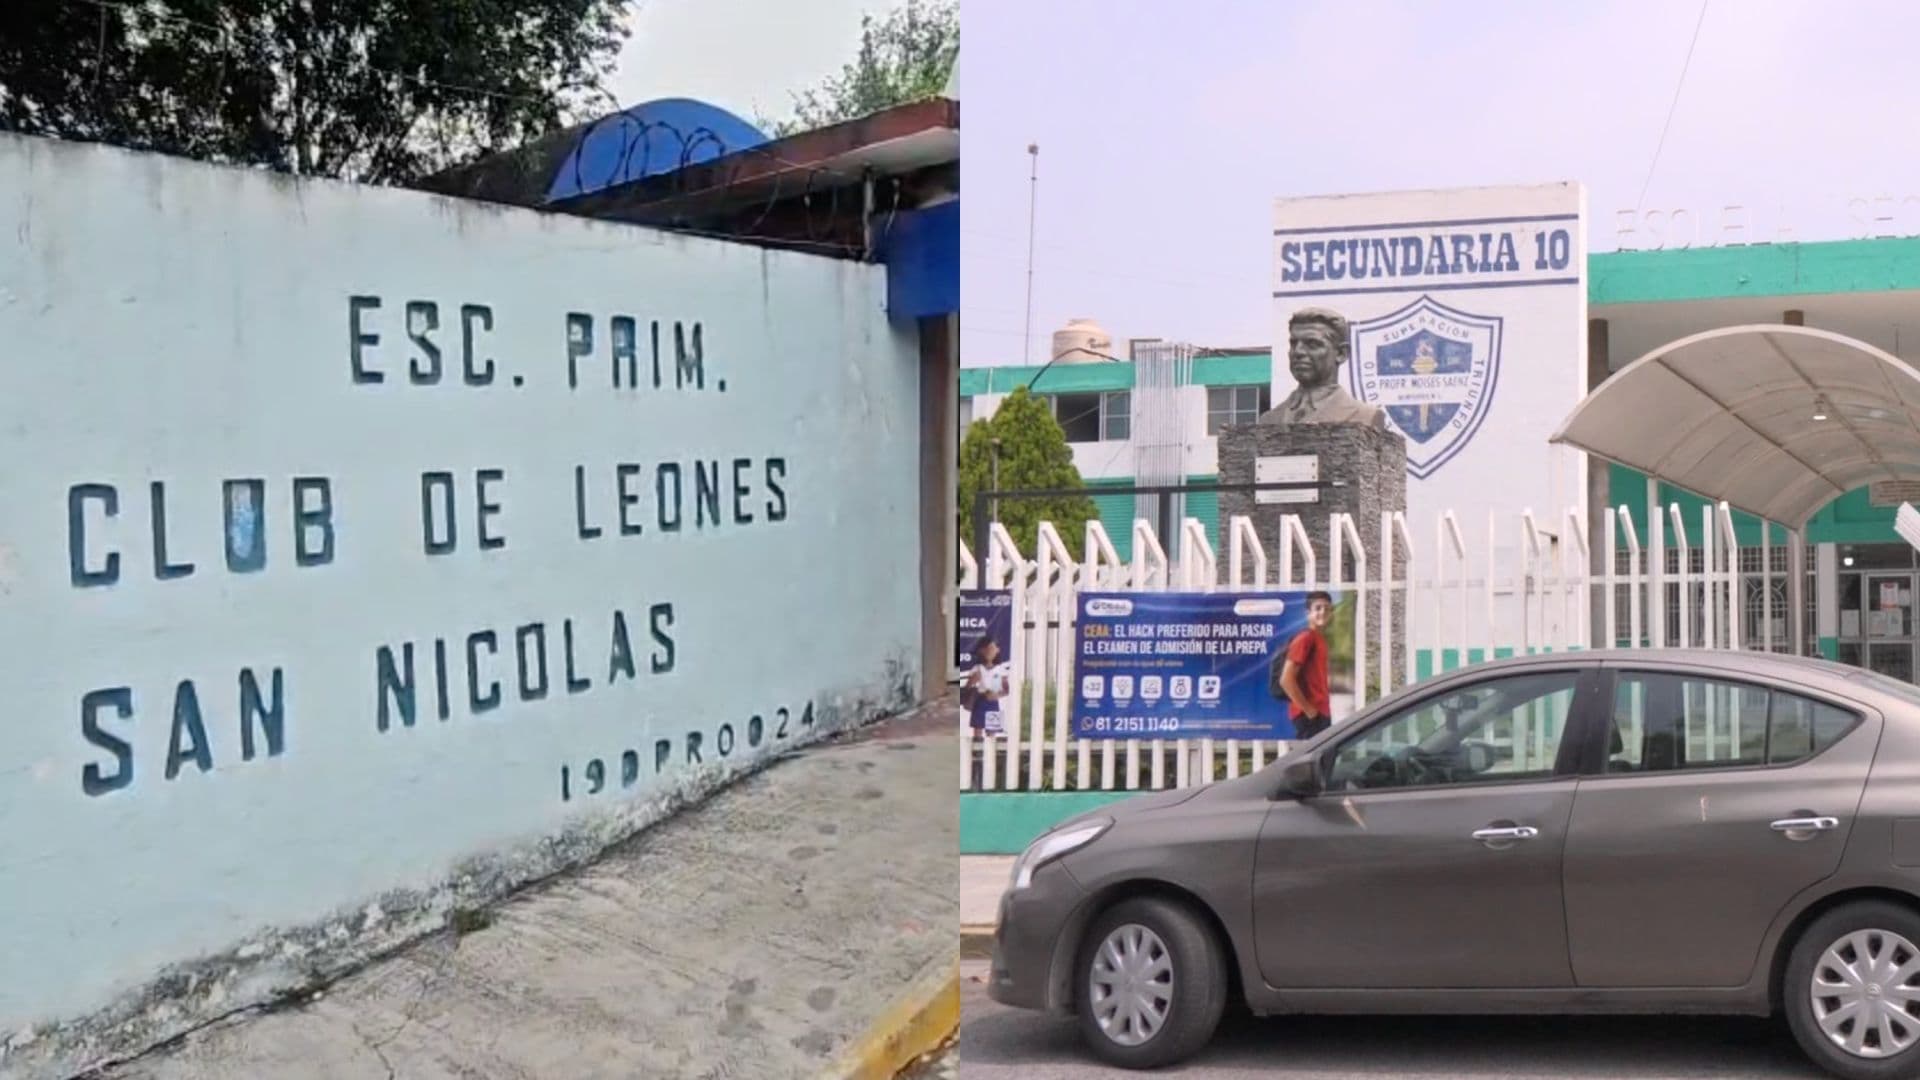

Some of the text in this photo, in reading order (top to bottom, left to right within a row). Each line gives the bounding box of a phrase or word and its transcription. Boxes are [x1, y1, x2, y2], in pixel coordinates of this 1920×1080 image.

[1281, 229, 1570, 283] SECUNDARIA 10
[349, 295, 727, 393] ESC. PRIM.
[1452, 359, 1485, 430] TRIUNFO
[68, 456, 788, 589] CLUB DE LEONES
[1083, 638, 1268, 654] EL EXAMEN DE ADMISIÓN DE LA PREPA
[1114, 623, 1126, 638] EL
[1128, 623, 1155, 638] HACK
[1156, 623, 1210, 638] PREFERIDO
[1212, 623, 1239, 638] PARA
[1240, 623, 1274, 638] PASAR
[81, 602, 676, 797] SAN NICOLAS
[1095, 716, 1112, 731] 81
[1113, 716, 1144, 731] 2151
[1147, 716, 1179, 731] 1140
